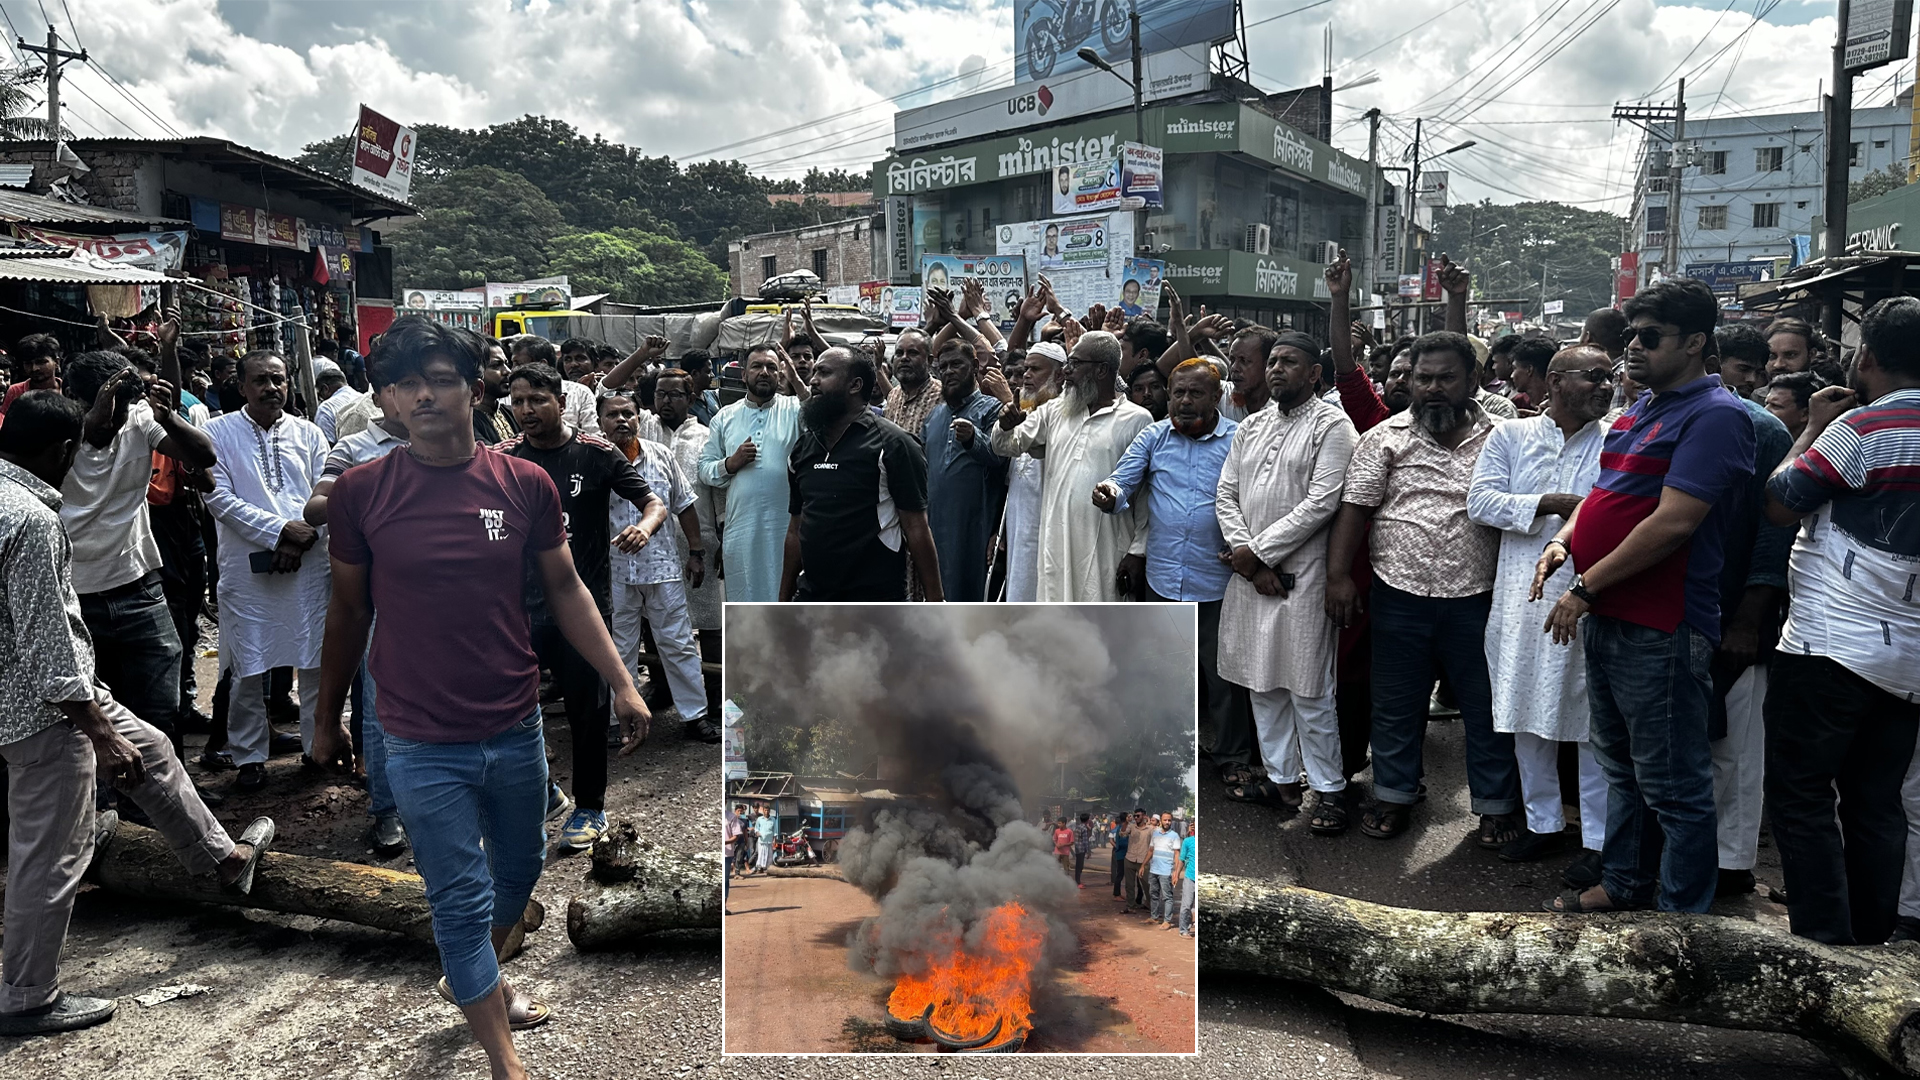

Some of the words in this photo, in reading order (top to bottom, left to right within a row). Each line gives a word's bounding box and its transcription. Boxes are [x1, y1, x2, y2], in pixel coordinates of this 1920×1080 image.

[1008, 95, 1036, 115] UCB
[1167, 118, 1235, 134] minister
[999, 137, 1115, 177] minister
[1274, 125, 1313, 172] মিনিস্টার
[886, 156, 977, 194] মিনিস্টার
[1328, 152, 1361, 192] minister
[895, 200, 907, 271] minister
[1380, 209, 1397, 272] minister
[1255, 259, 1298, 296] মিনিস্টার
[1687, 264, 1716, 278] মেসার্স
[479, 508, 504, 520] JUST
[485, 518, 503, 529] DO
